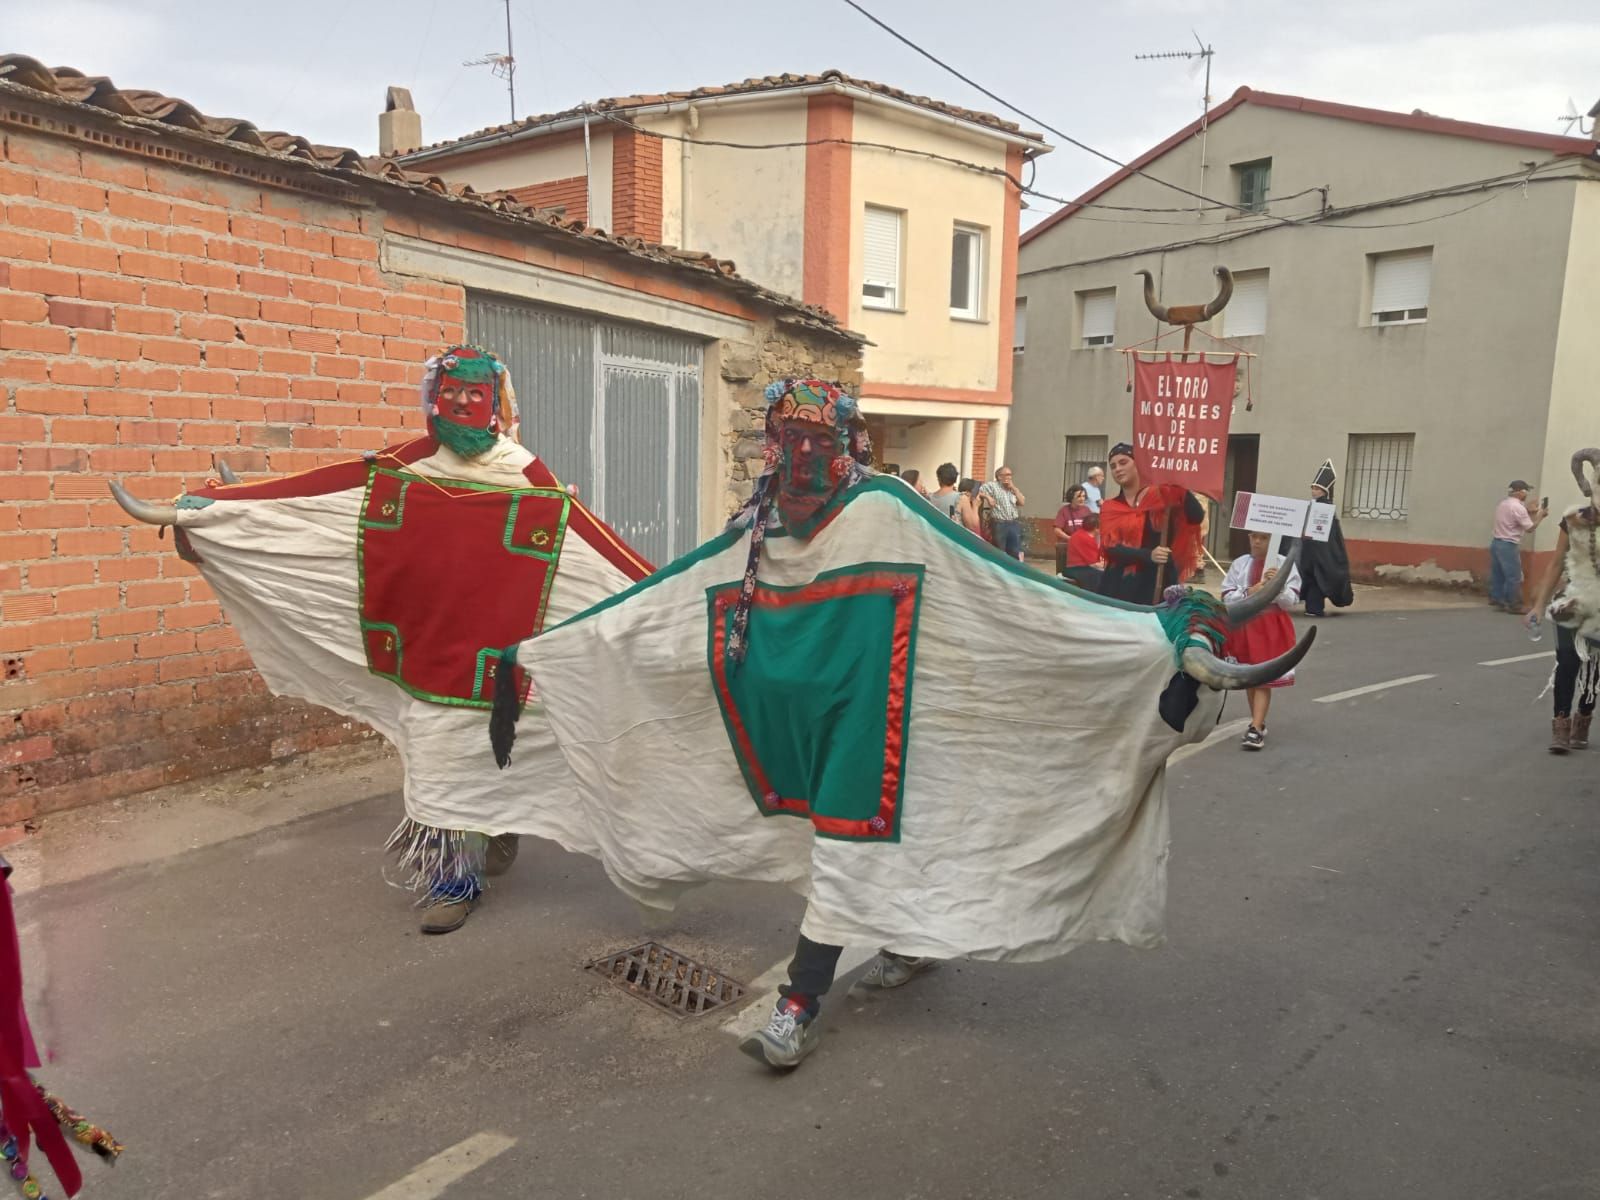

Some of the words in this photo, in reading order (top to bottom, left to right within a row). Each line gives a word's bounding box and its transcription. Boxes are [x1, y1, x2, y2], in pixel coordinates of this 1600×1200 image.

[1158, 375, 1172, 397] EL
[1176, 376, 1208, 399] TORO
[1141, 401, 1221, 420] MORALES
[1170, 419, 1186, 435] DE
[1138, 432, 1219, 455] VALVERDE
[1151, 455, 1199, 472] ZAMORA
